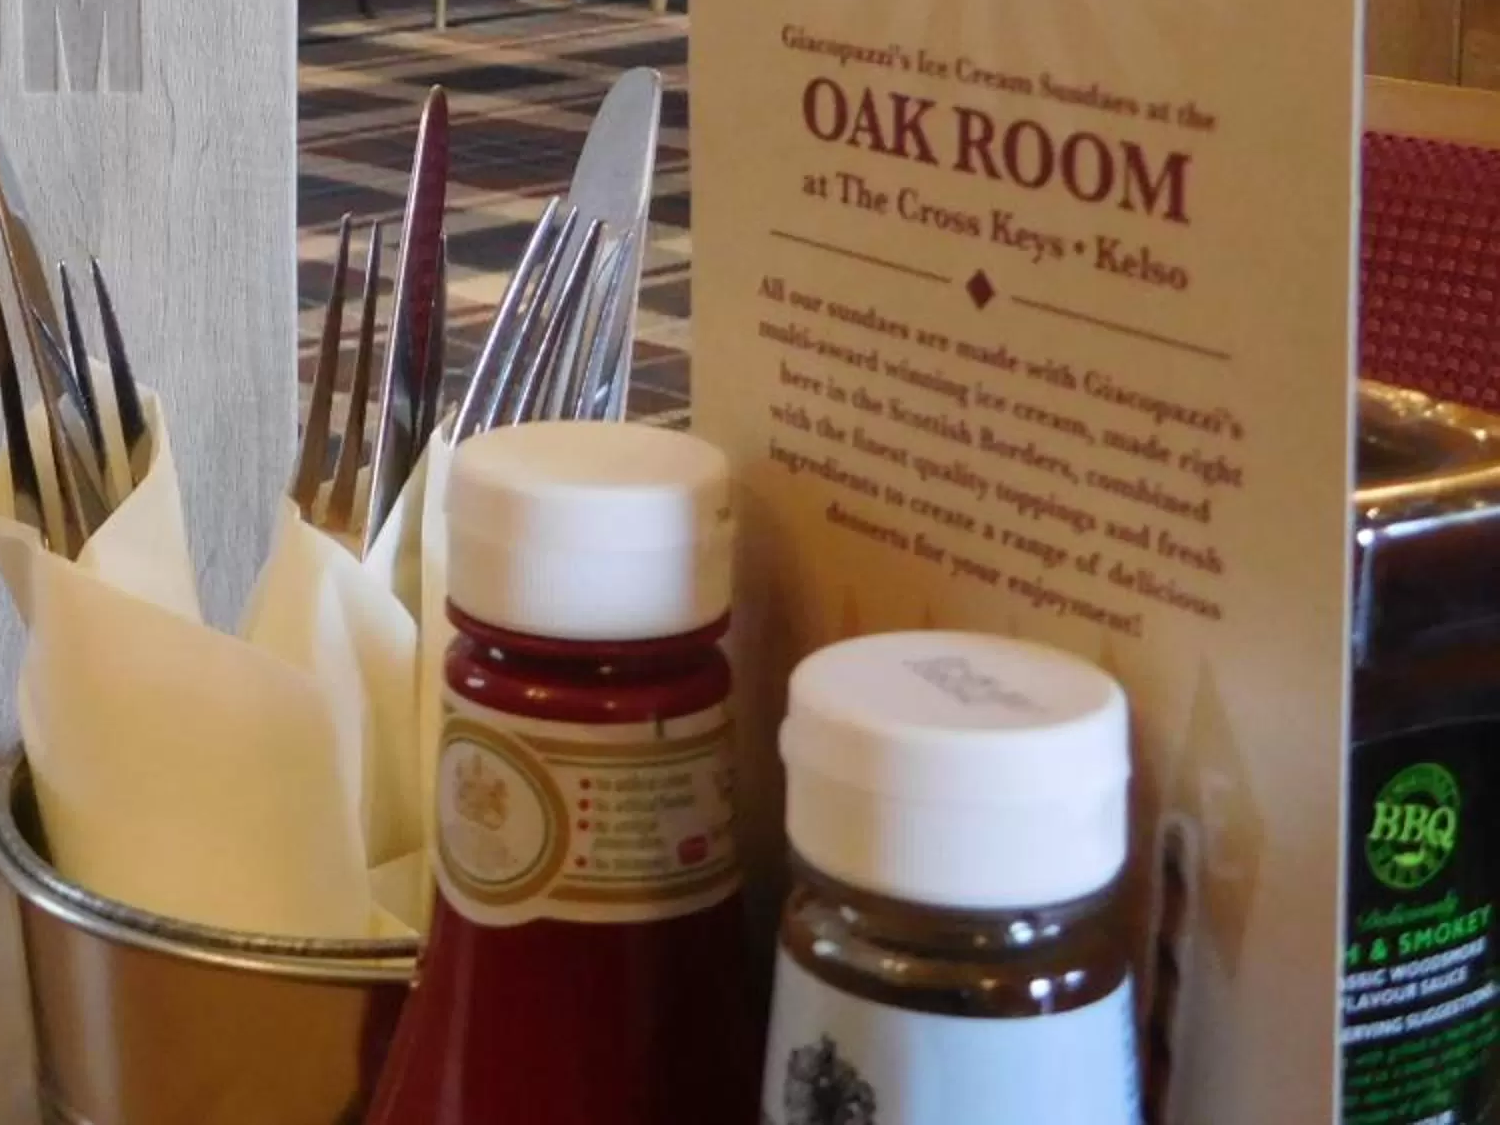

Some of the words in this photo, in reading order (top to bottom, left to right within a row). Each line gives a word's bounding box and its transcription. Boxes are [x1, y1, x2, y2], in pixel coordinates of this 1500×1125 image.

[781, 24, 910, 71] Giacopazzi's
[917, 49, 948, 80] Ice
[955, 57, 1034, 97] Cream
[1039, 74, 1139, 119] Sundaes
[1146, 101, 1170, 123] at
[1177, 106, 1217, 132] the
[803, 77, 939, 166] OAK
[952, 105, 1192, 225] ROOM
[803, 173, 827, 199] at
[836, 171, 888, 213] The
[896, 188, 981, 239] Cross
[990, 210, 1064, 265] Keys
[1094, 235, 1189, 292] Kelso
[757, 275, 785, 303] All
[790, 289, 822, 309] our
[827, 293, 910, 341] sundaes
[916, 326, 950, 349] are
[957, 335, 1019, 373] made
[1025, 358, 1077, 391] with
[1083, 369, 1245, 441] Giacopazzi's
[758, 317, 878, 373] multi-award
[884, 356, 969, 409] winning
[974, 381, 1008, 413] ice
[1013, 401, 1096, 445] cream,
[1103, 427, 1171, 466] made
[1178, 450, 1243, 489] right
[769, 401, 812, 434] with
[816, 413, 847, 443] the
[852, 426, 907, 467] finest
[913, 452, 989, 501] quality
[996, 477, 1097, 534] toppings
[1105, 518, 1150, 555] and
[1157, 530, 1224, 575] fresh
[779, 361, 822, 397] here
[827, 375, 847, 403] in
[852, 385, 884, 420] the
[888, 396, 973, 446] Scottish
[1086, 467, 1211, 525] combined
[769, 439, 880, 504] ingredients
[885, 483, 904, 507] to
[909, 497, 975, 533] create
[982, 523, 995, 541] a
[1002, 527, 1068, 569] range
[1075, 550, 1102, 575] of
[1108, 558, 1221, 621] delicious
[825, 501, 910, 552] desserts
[913, 531, 946, 563] for
[950, 554, 1000, 587] your
[1369, 801, 1457, 849] BBQ
[1399, 903, 1492, 954] SMOKEY
[1343, 984, 1417, 1015] LAVOUR
